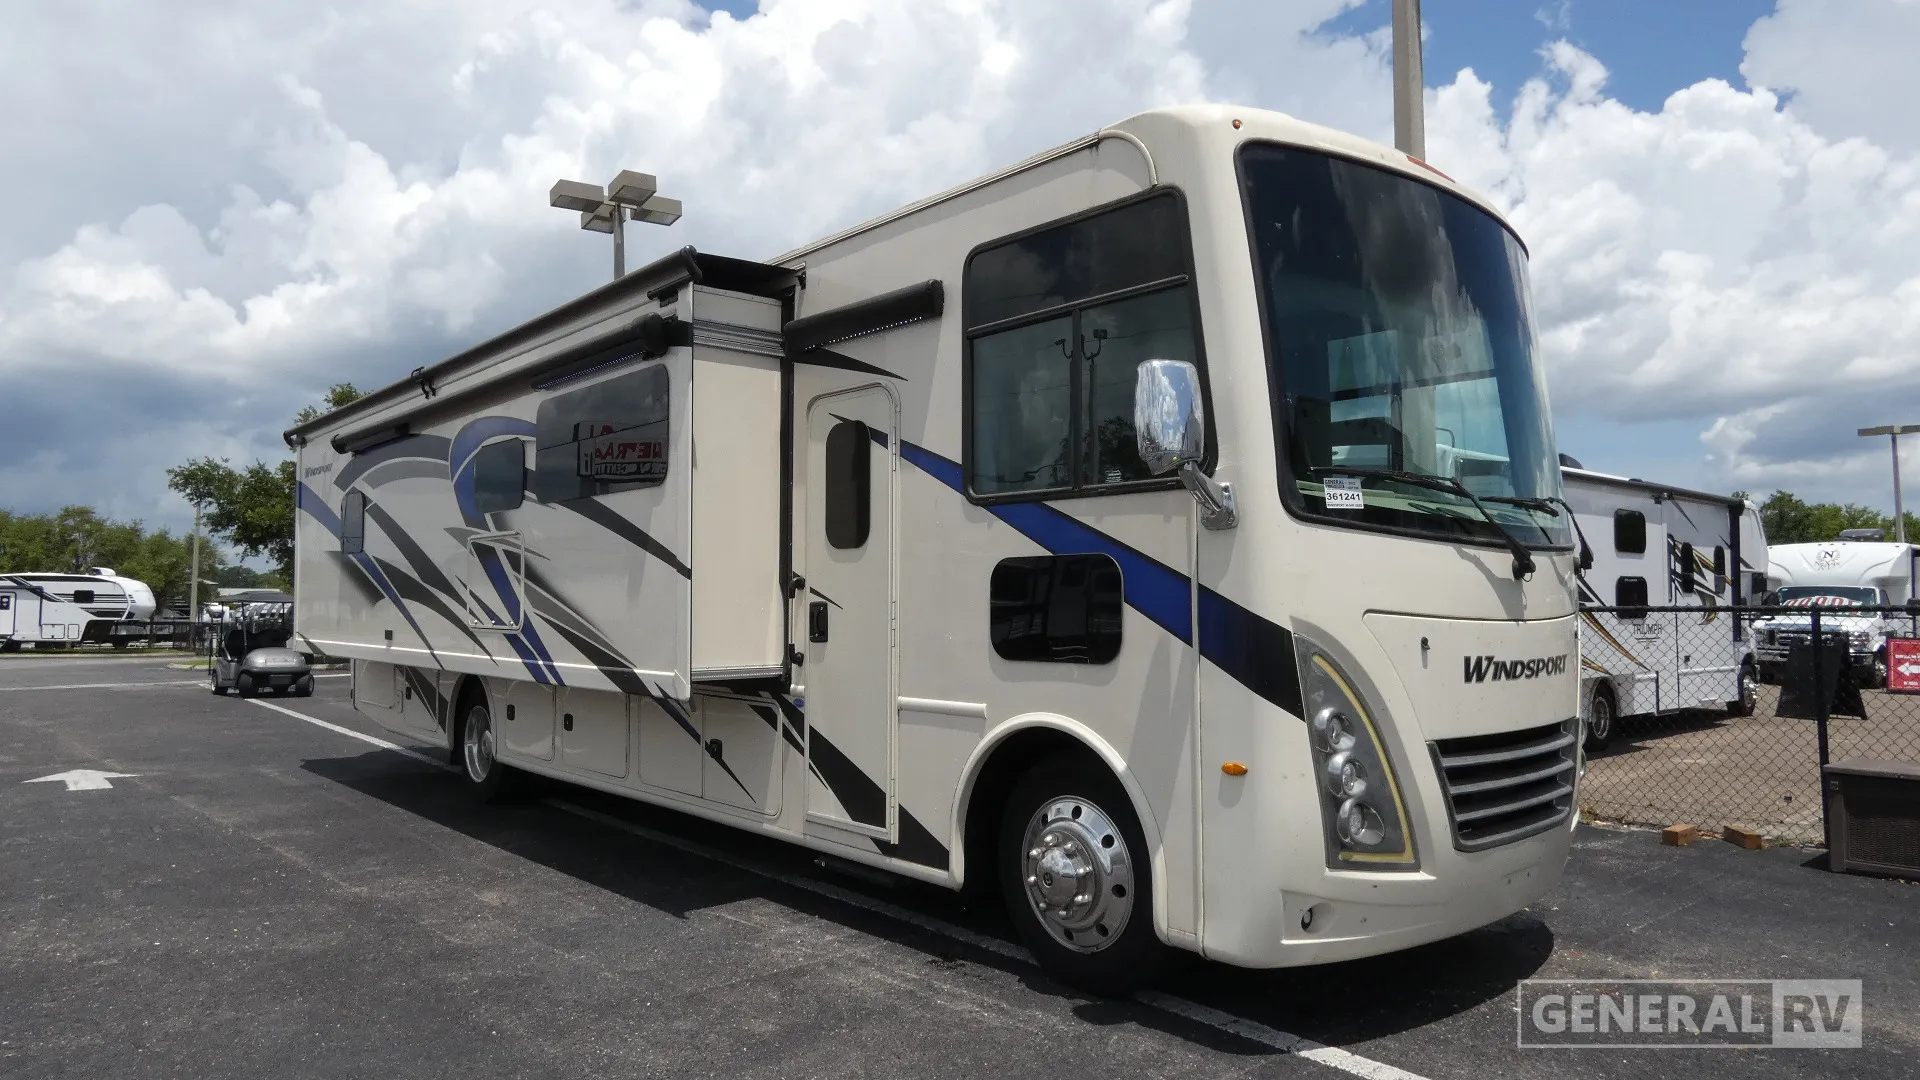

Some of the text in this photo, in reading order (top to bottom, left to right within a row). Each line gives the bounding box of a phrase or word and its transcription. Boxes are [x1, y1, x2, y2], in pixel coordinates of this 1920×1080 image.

[1326, 492, 1361, 501] 361241
[1632, 624, 1663, 635] TRIUMPH
[1463, 654, 1568, 684] WINDSPORT
